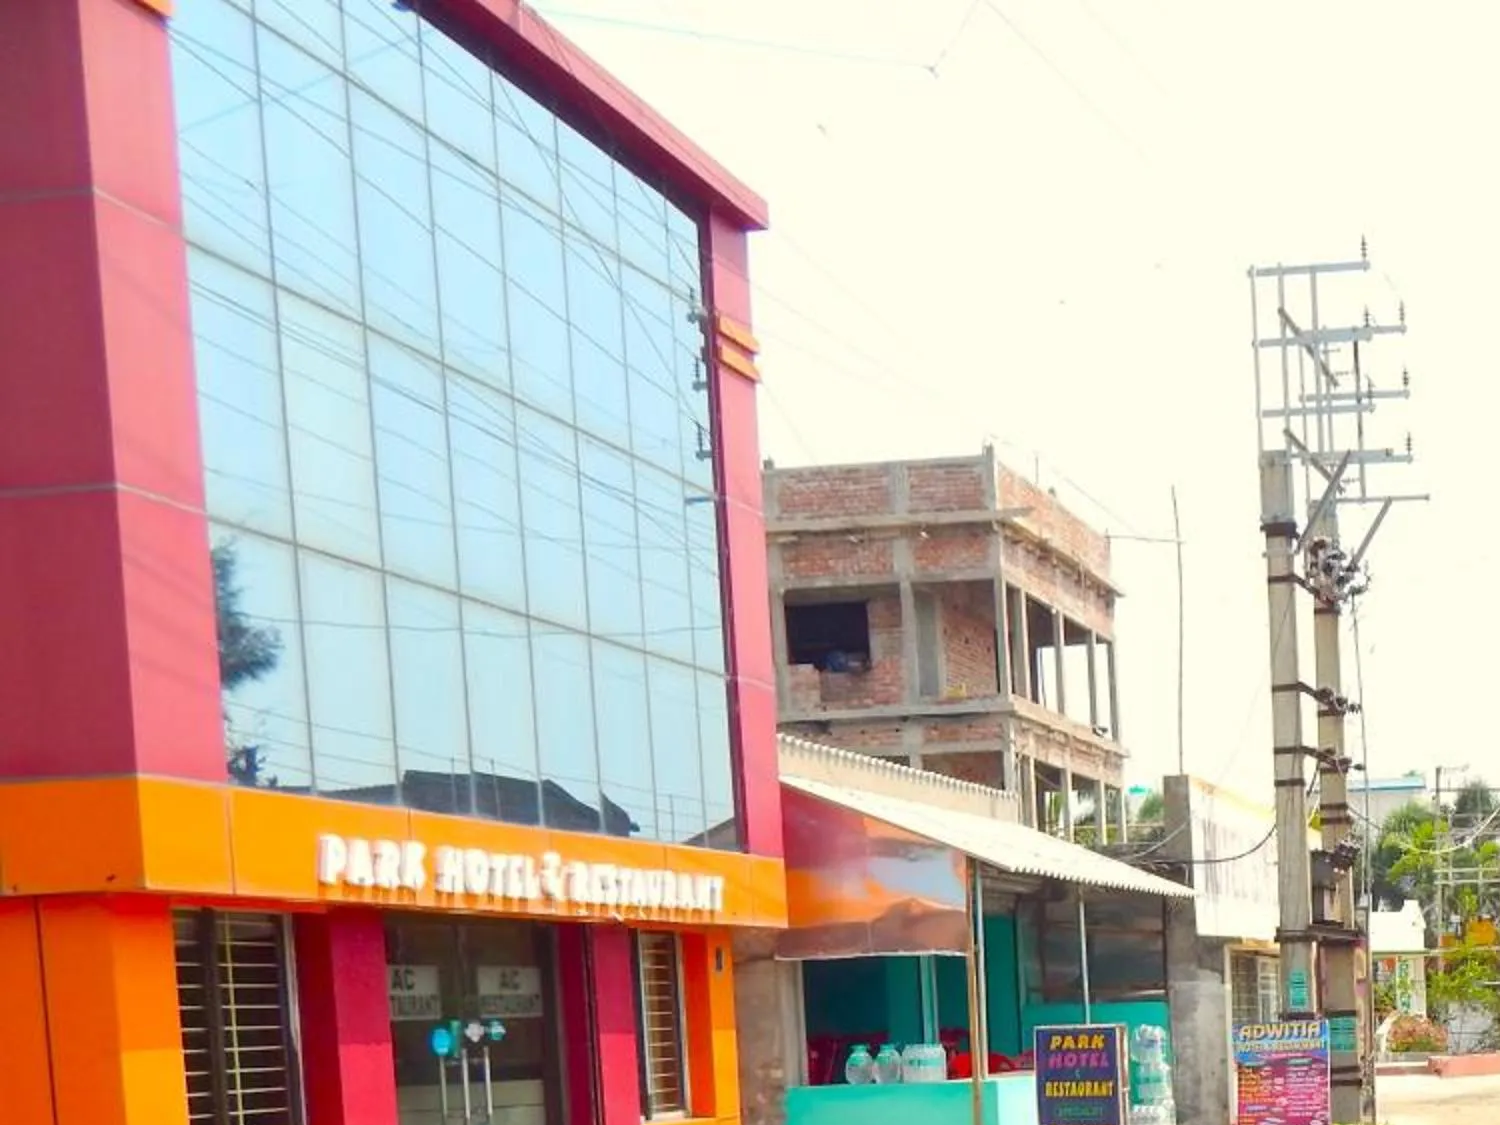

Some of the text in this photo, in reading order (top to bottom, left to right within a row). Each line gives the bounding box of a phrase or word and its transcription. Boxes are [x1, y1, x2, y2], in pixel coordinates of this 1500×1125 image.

[317, 834, 427, 890] PARK
[434, 845, 540, 900] HOTEL
[565, 861, 725, 912] RESTAURANT
[391, 968, 416, 991] AC
[1240, 1022, 1321, 1041] ADWITIA
[1050, 1035, 1105, 1050] PARK
[1048, 1052, 1110, 1068] HOTEL
[1045, 1081, 1113, 1097] RESTAURANT
